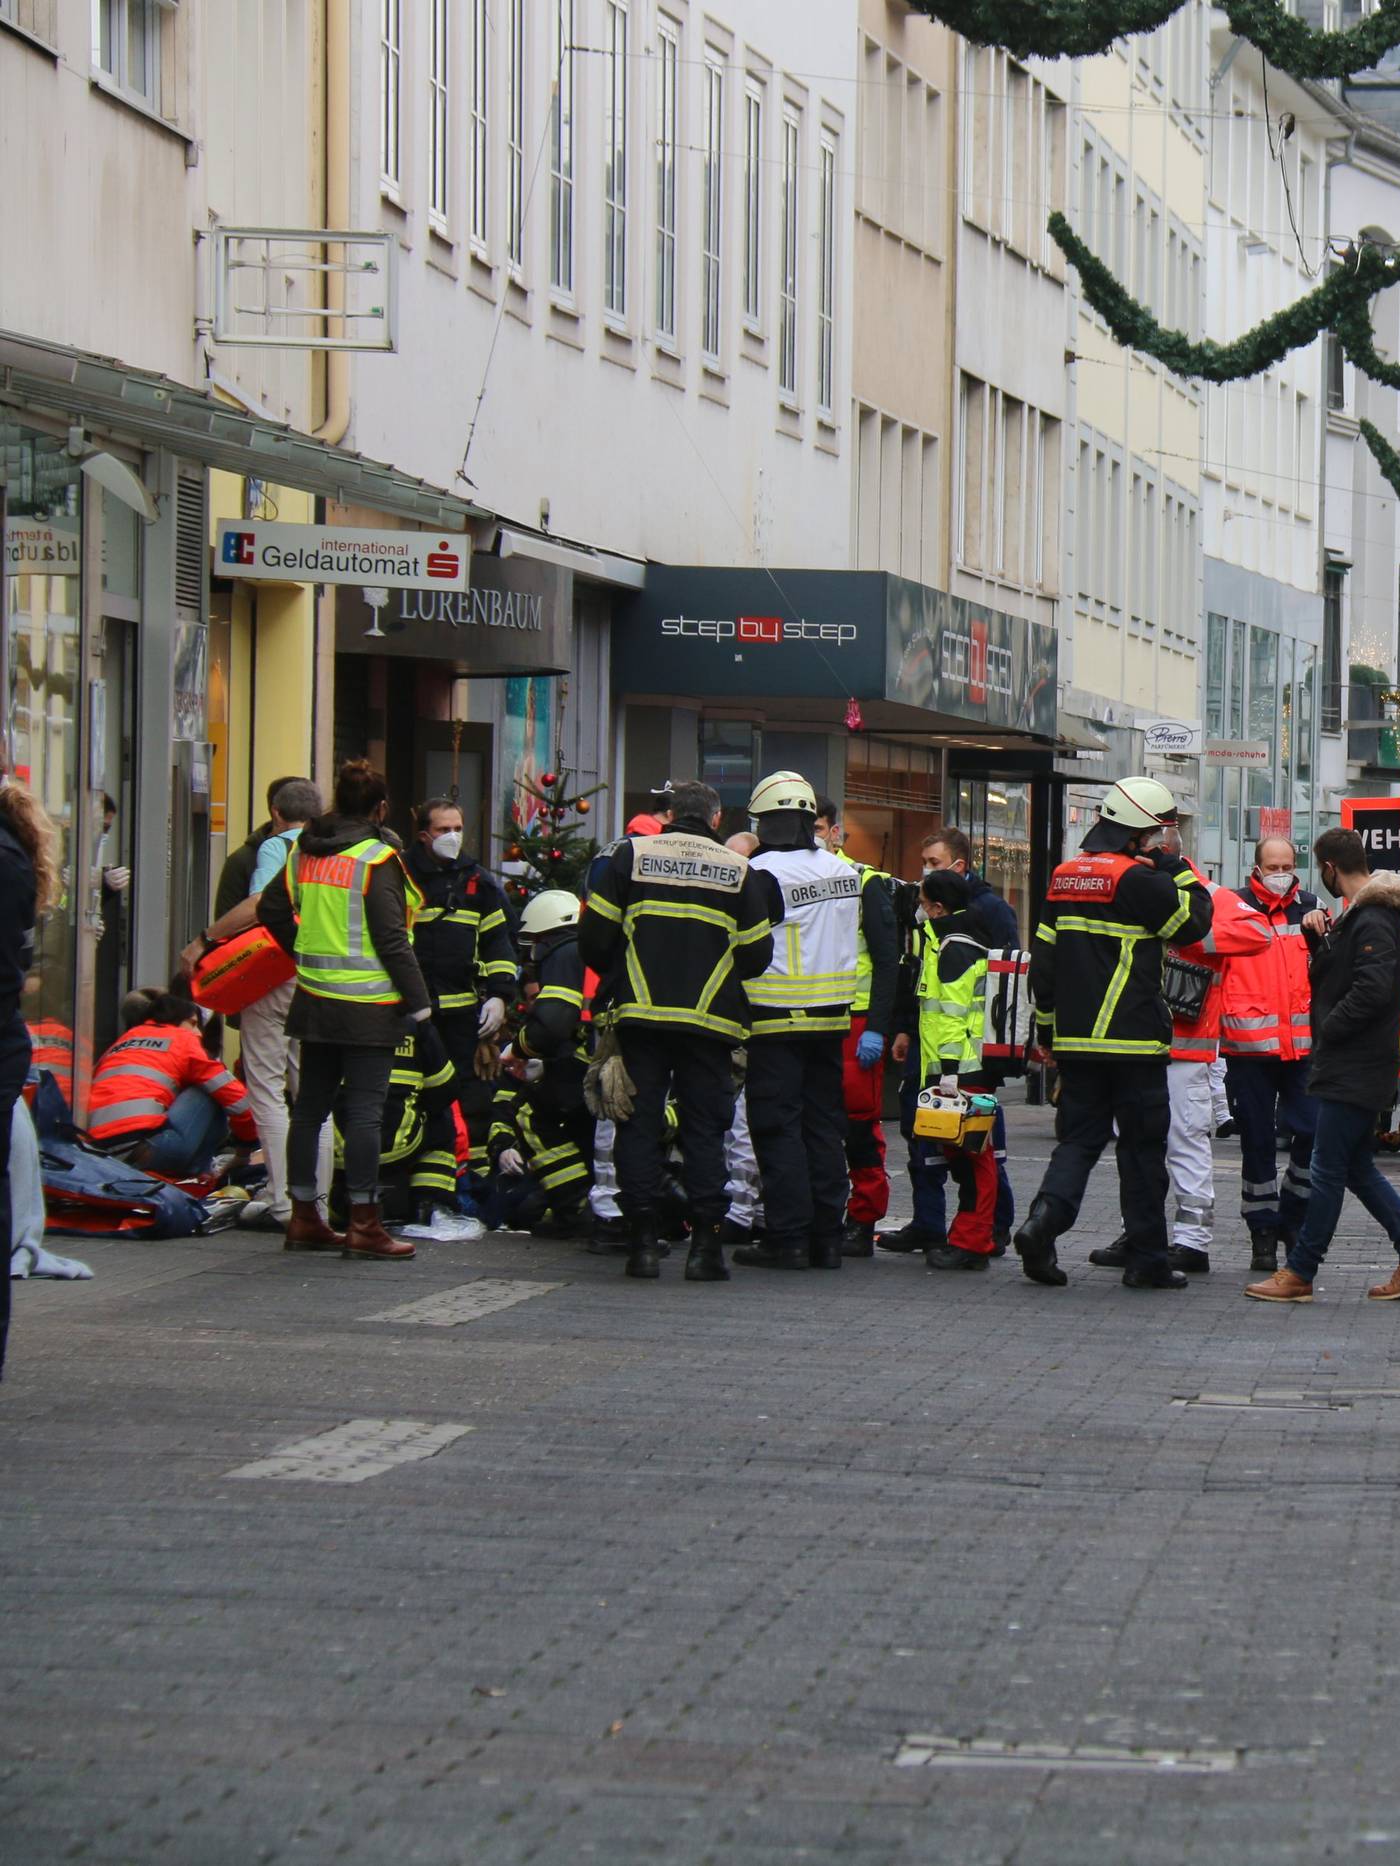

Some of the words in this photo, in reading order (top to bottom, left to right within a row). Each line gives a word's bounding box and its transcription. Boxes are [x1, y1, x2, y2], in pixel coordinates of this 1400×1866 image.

[320, 537, 409, 557] international
[261, 545, 420, 577] Geldautomat
[661, 615, 736, 643] step
[740, 617, 779, 642] by
[783, 618, 857, 646] step
[641, 857, 738, 882] EINSATZLEITER
[1053, 875, 1105, 891] ZUGFÜHRER
[1106, 879, 1112, 891] 1
